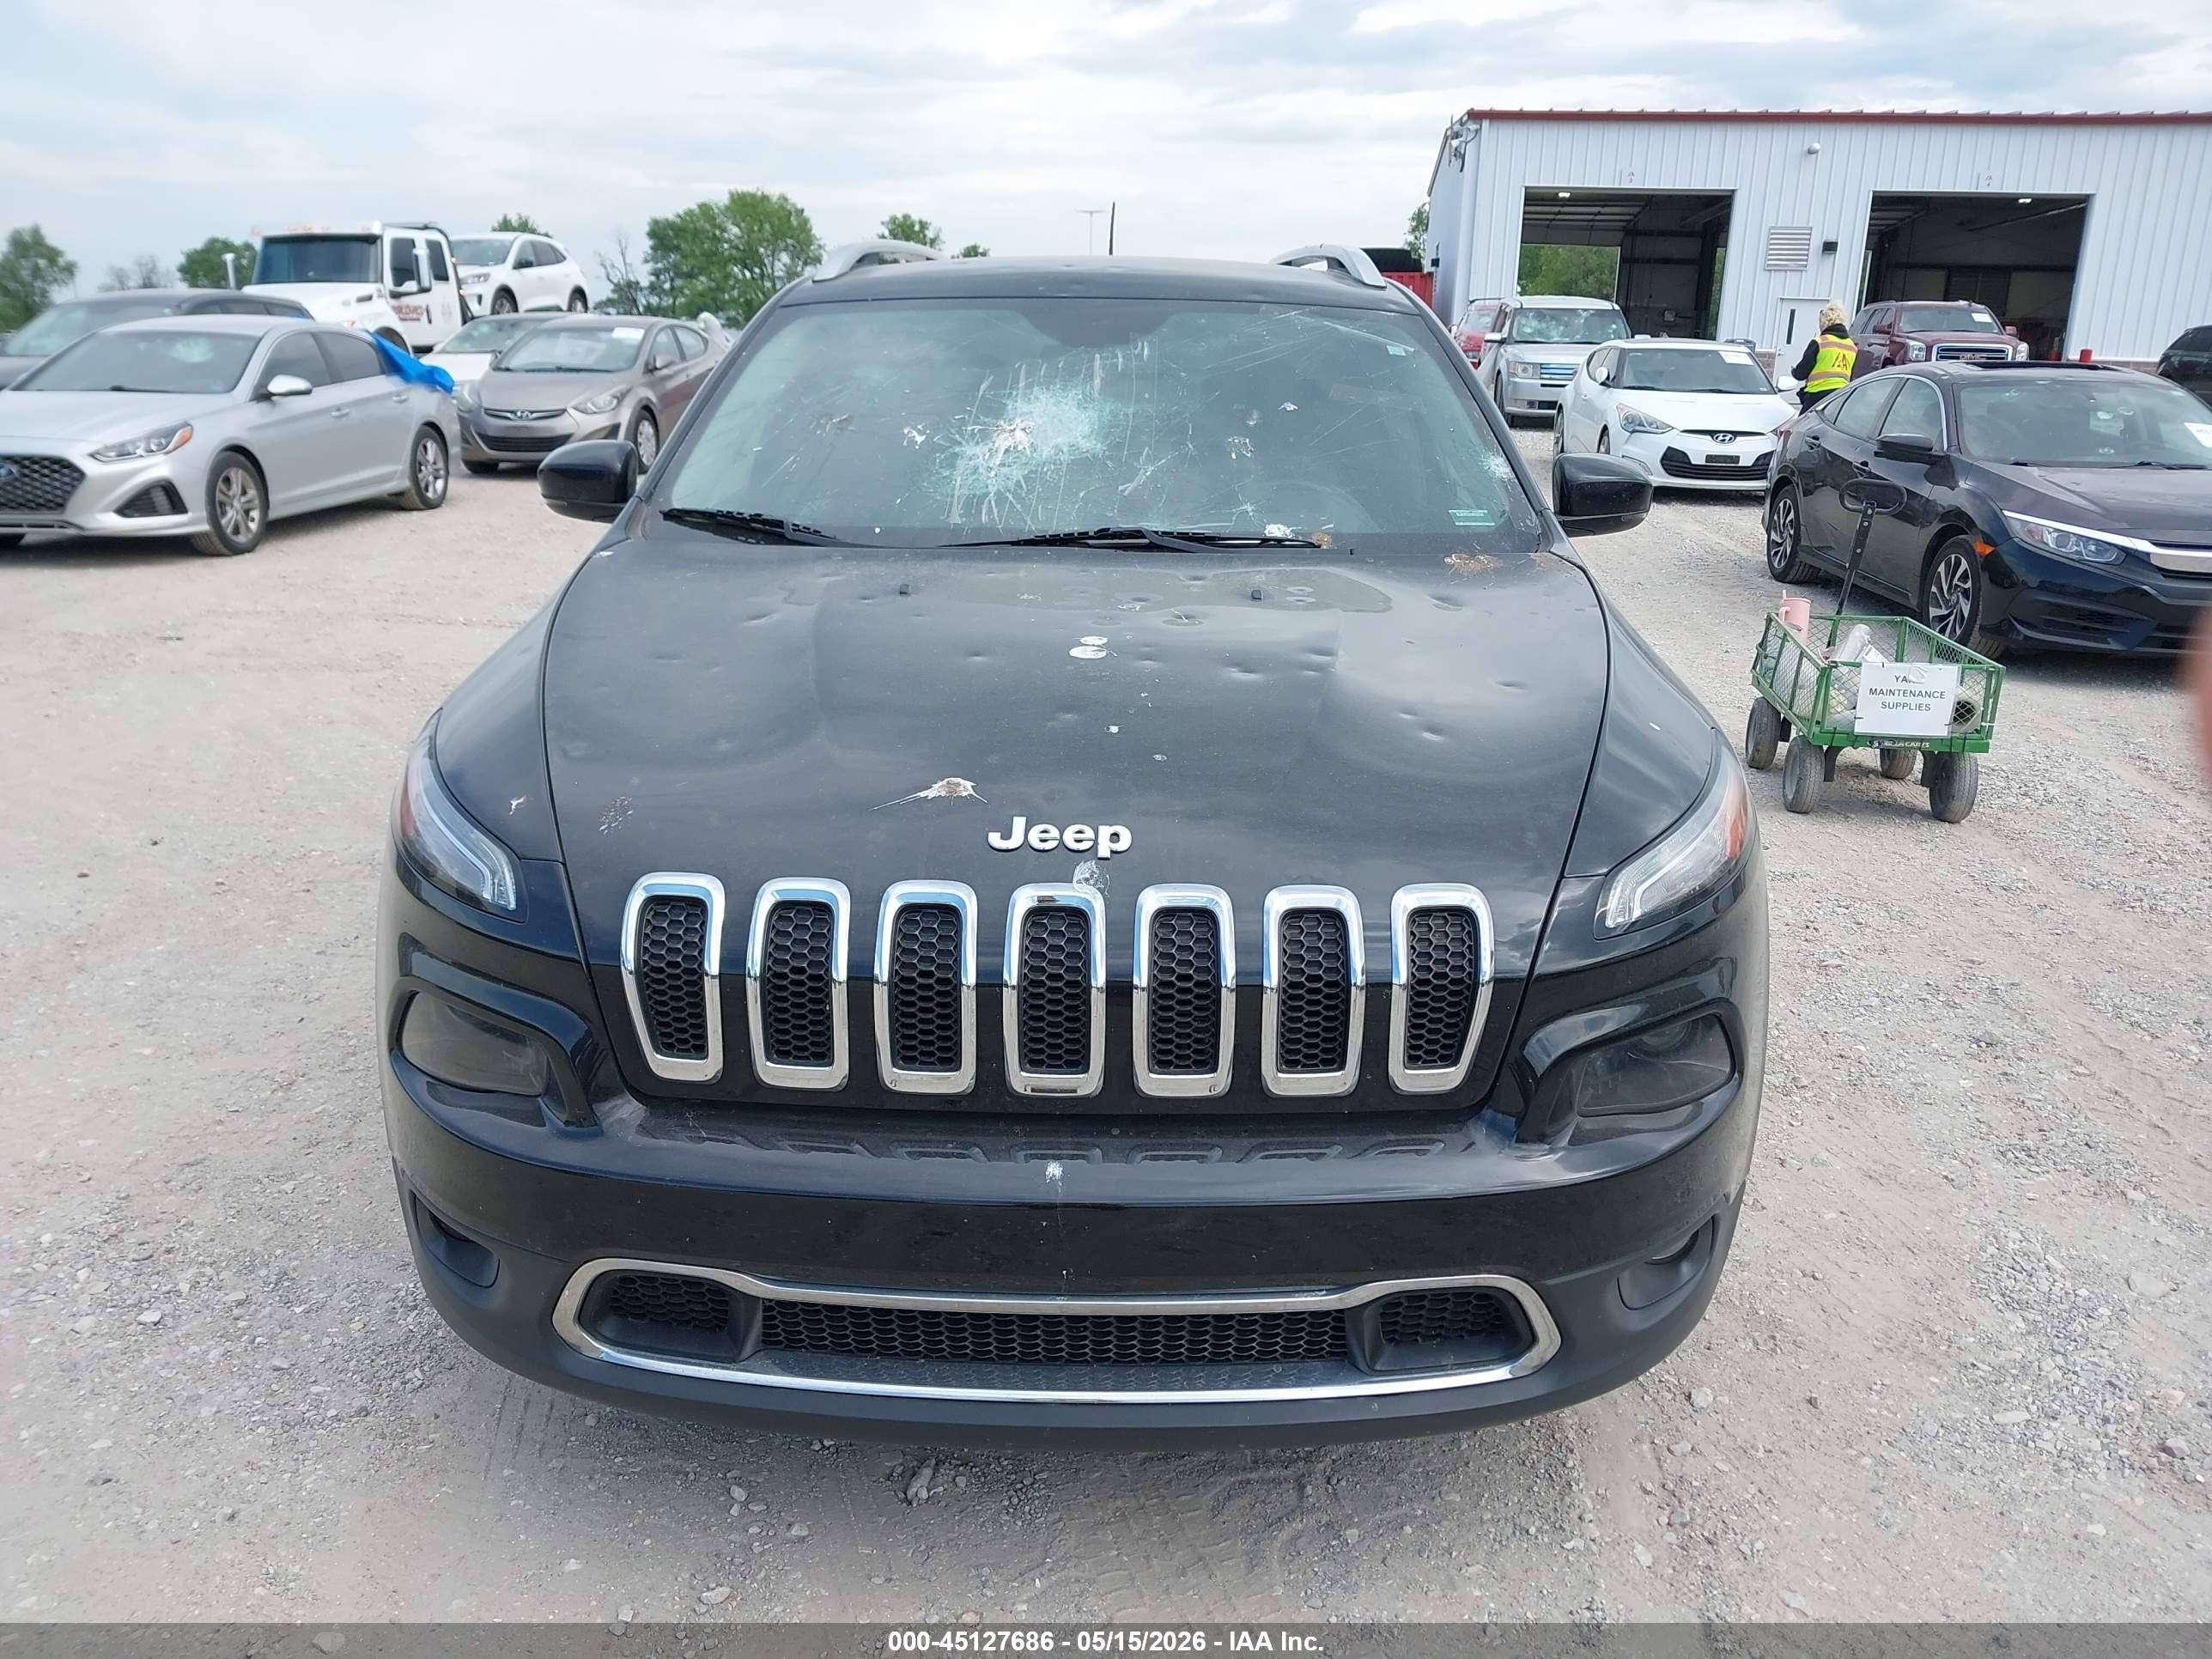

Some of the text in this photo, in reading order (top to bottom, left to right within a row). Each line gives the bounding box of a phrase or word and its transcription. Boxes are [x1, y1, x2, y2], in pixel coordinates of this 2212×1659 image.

[1869, 687, 1947, 699] MAINTENANCE
[1881, 701, 1931, 712] SUPPLIES
[988, 816, 1133, 860] Jeep
